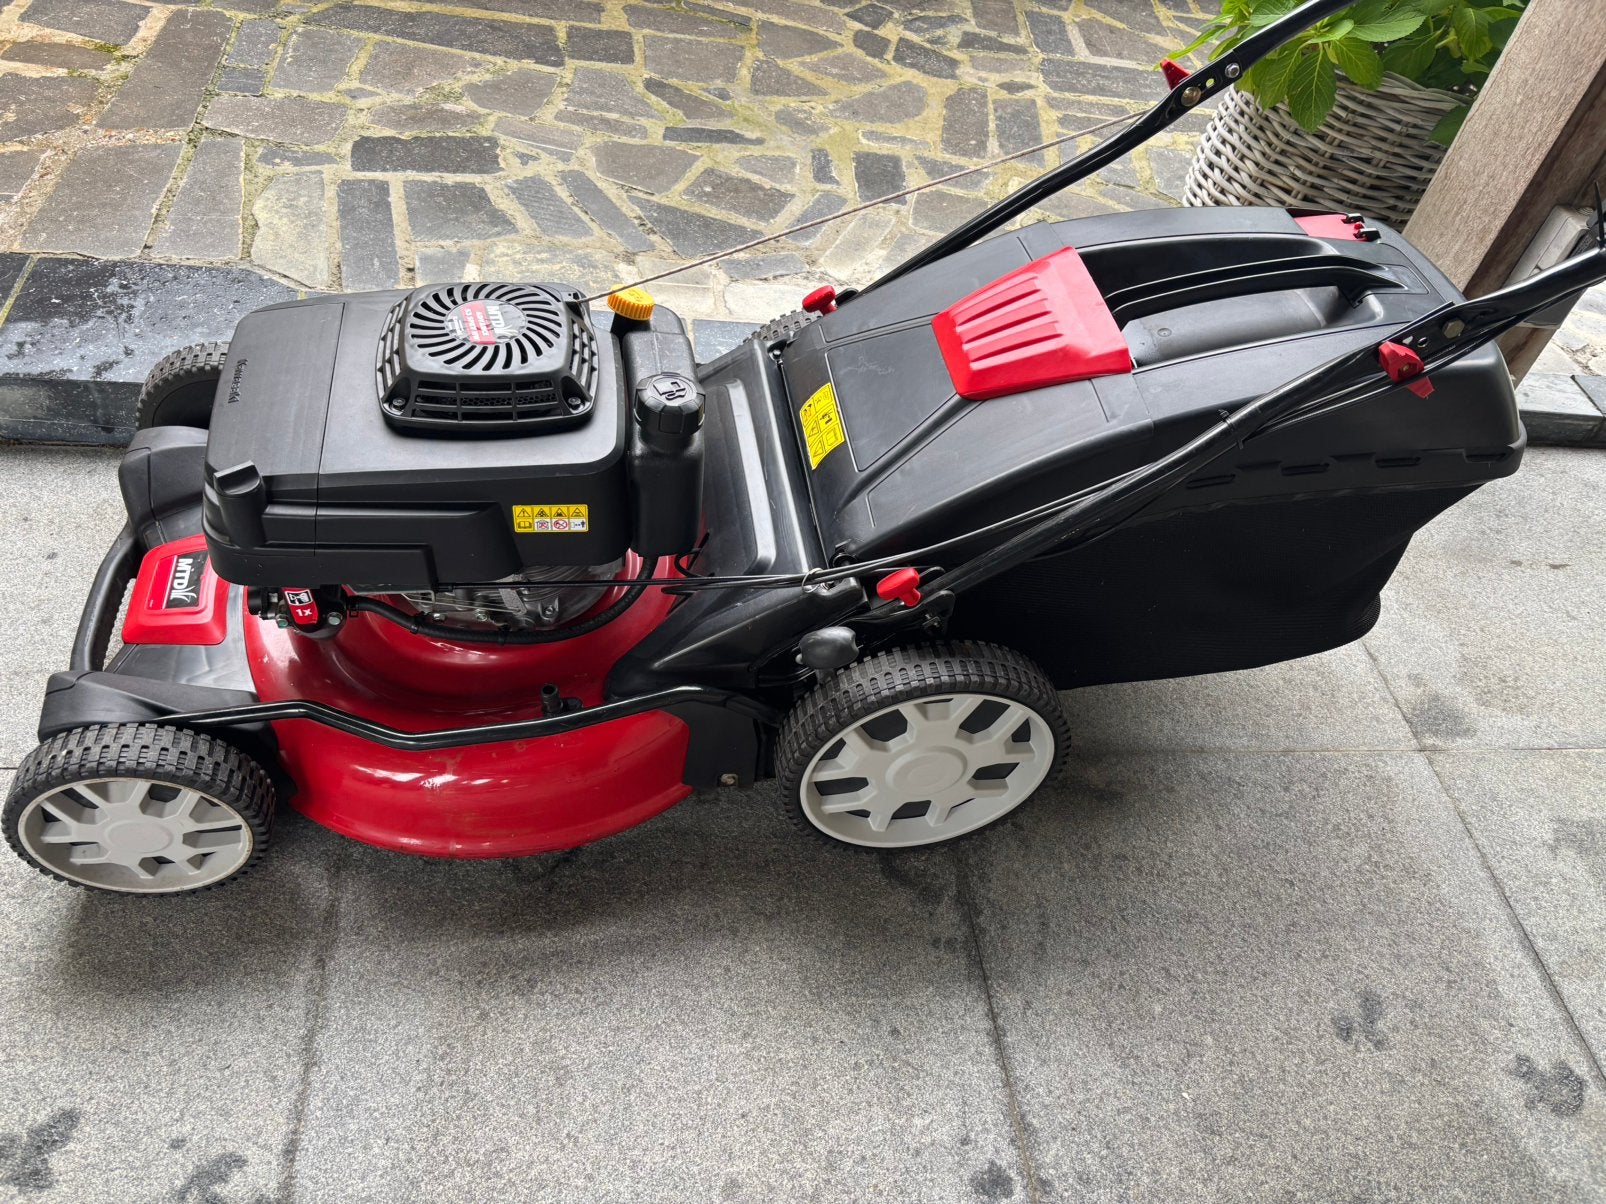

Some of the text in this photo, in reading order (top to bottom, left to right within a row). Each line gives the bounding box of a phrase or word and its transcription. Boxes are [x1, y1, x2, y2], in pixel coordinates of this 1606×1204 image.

[485, 305, 505, 328] MTD
[173, 558, 194, 589] MTD
[296, 608, 313, 617] 1x
